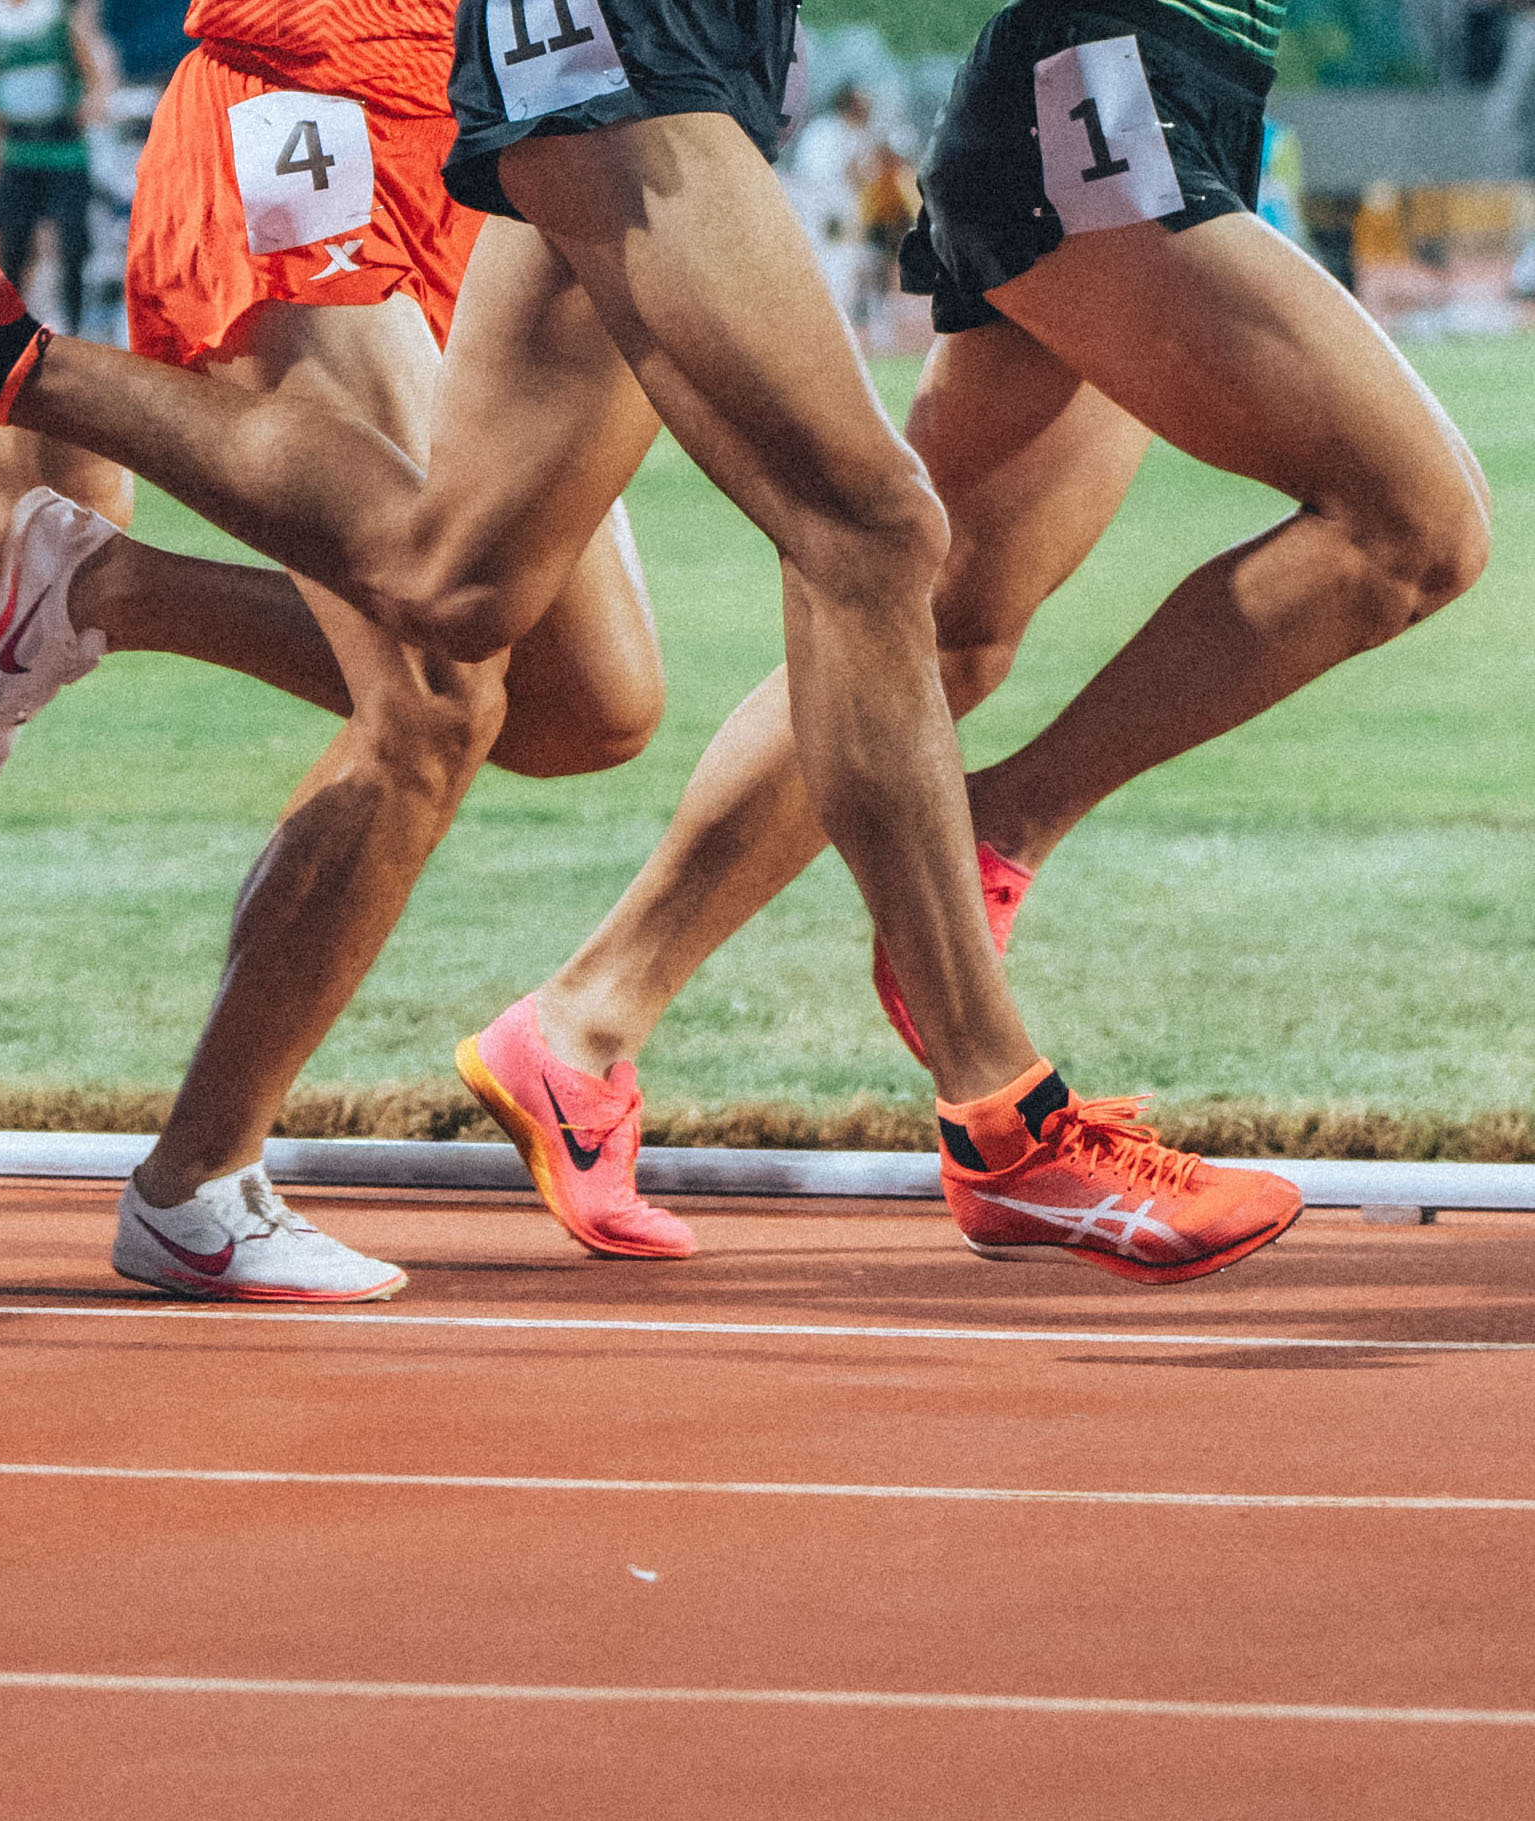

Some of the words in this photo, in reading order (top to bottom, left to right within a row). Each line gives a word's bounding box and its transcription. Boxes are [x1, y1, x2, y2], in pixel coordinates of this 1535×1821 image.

[504, 0, 595, 66] 11
[275, 120, 335, 191] 4
[1068, 97, 1130, 183] 1
